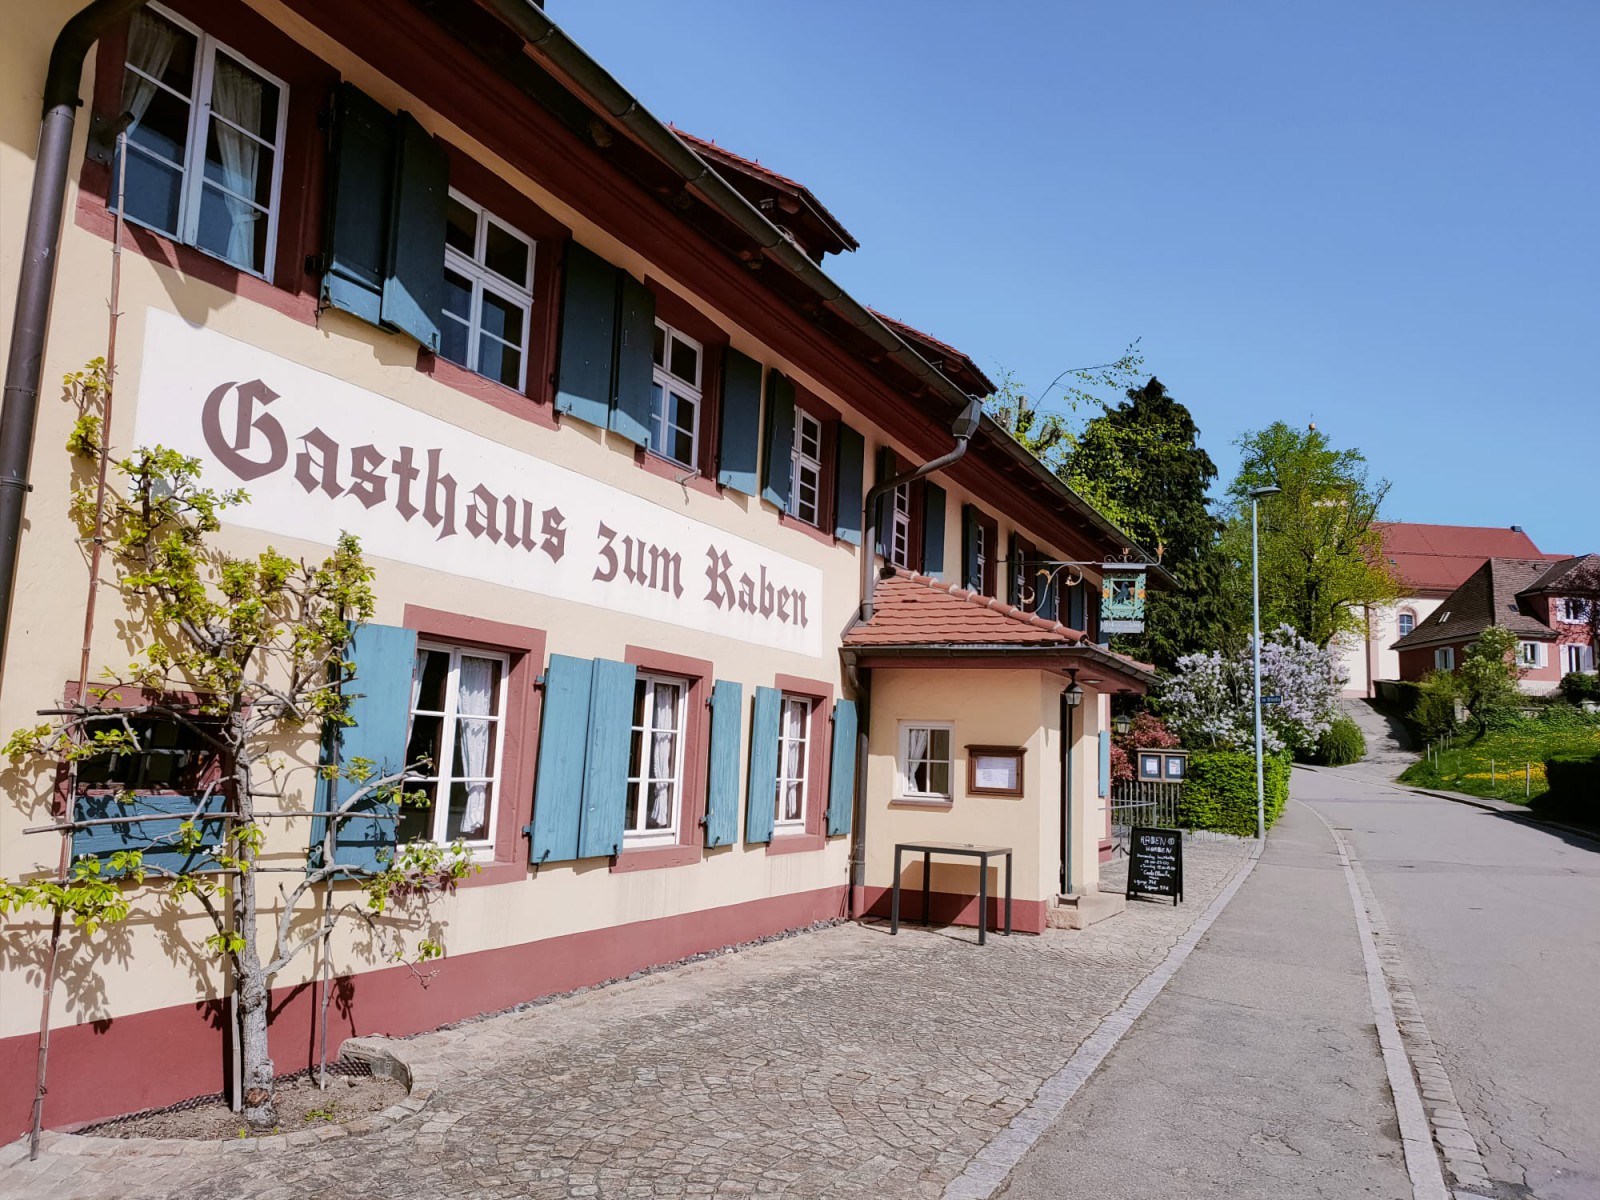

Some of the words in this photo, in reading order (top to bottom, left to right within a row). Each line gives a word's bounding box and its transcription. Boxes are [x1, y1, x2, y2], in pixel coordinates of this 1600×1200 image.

[202, 378, 567, 564] Gasthaus
[592, 520, 684, 599] zum
[704, 544, 808, 628] Raben
